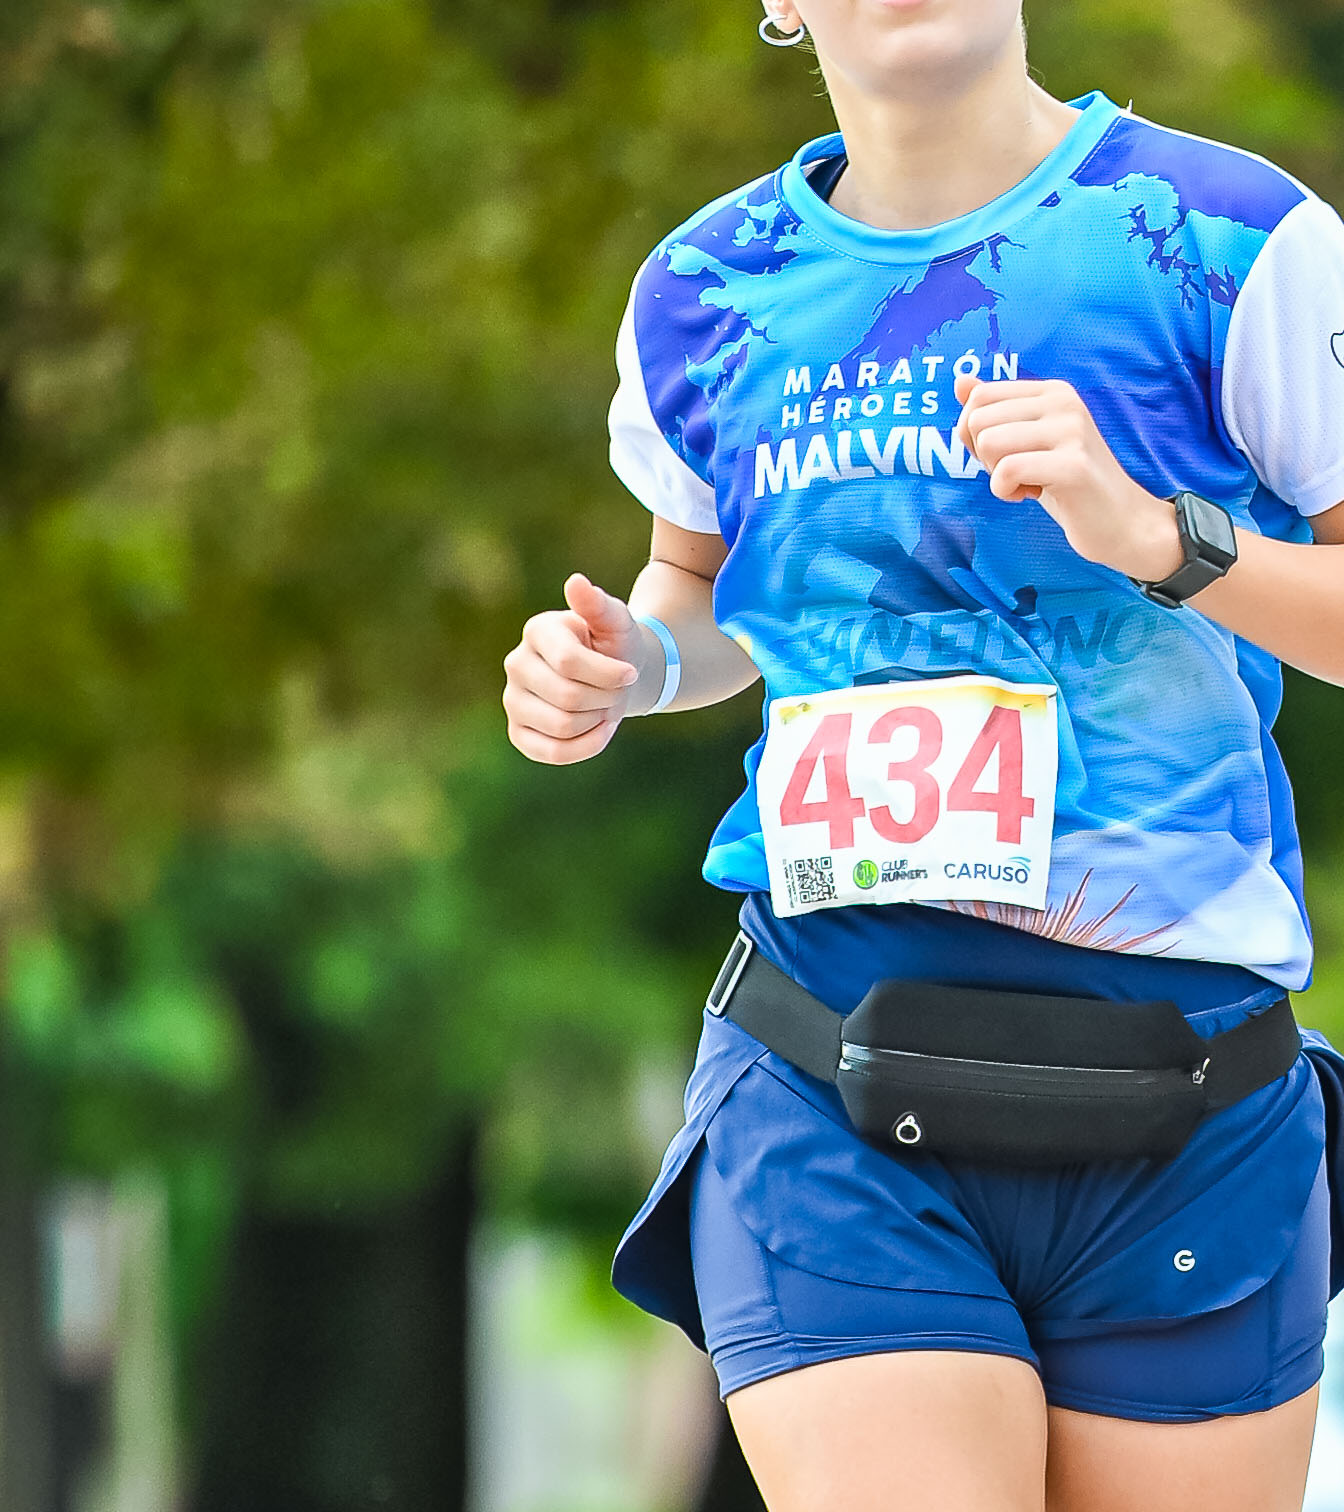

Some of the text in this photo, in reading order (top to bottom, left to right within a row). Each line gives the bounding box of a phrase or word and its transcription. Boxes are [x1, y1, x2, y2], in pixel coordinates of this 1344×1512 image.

[782, 349, 1019, 397] MARATÓN
[780, 391, 940, 429] HÉROES
[779, 705, 1035, 850] 434
[881, 859, 909, 872] CLUB
[943, 862, 1029, 884] CARUSO
